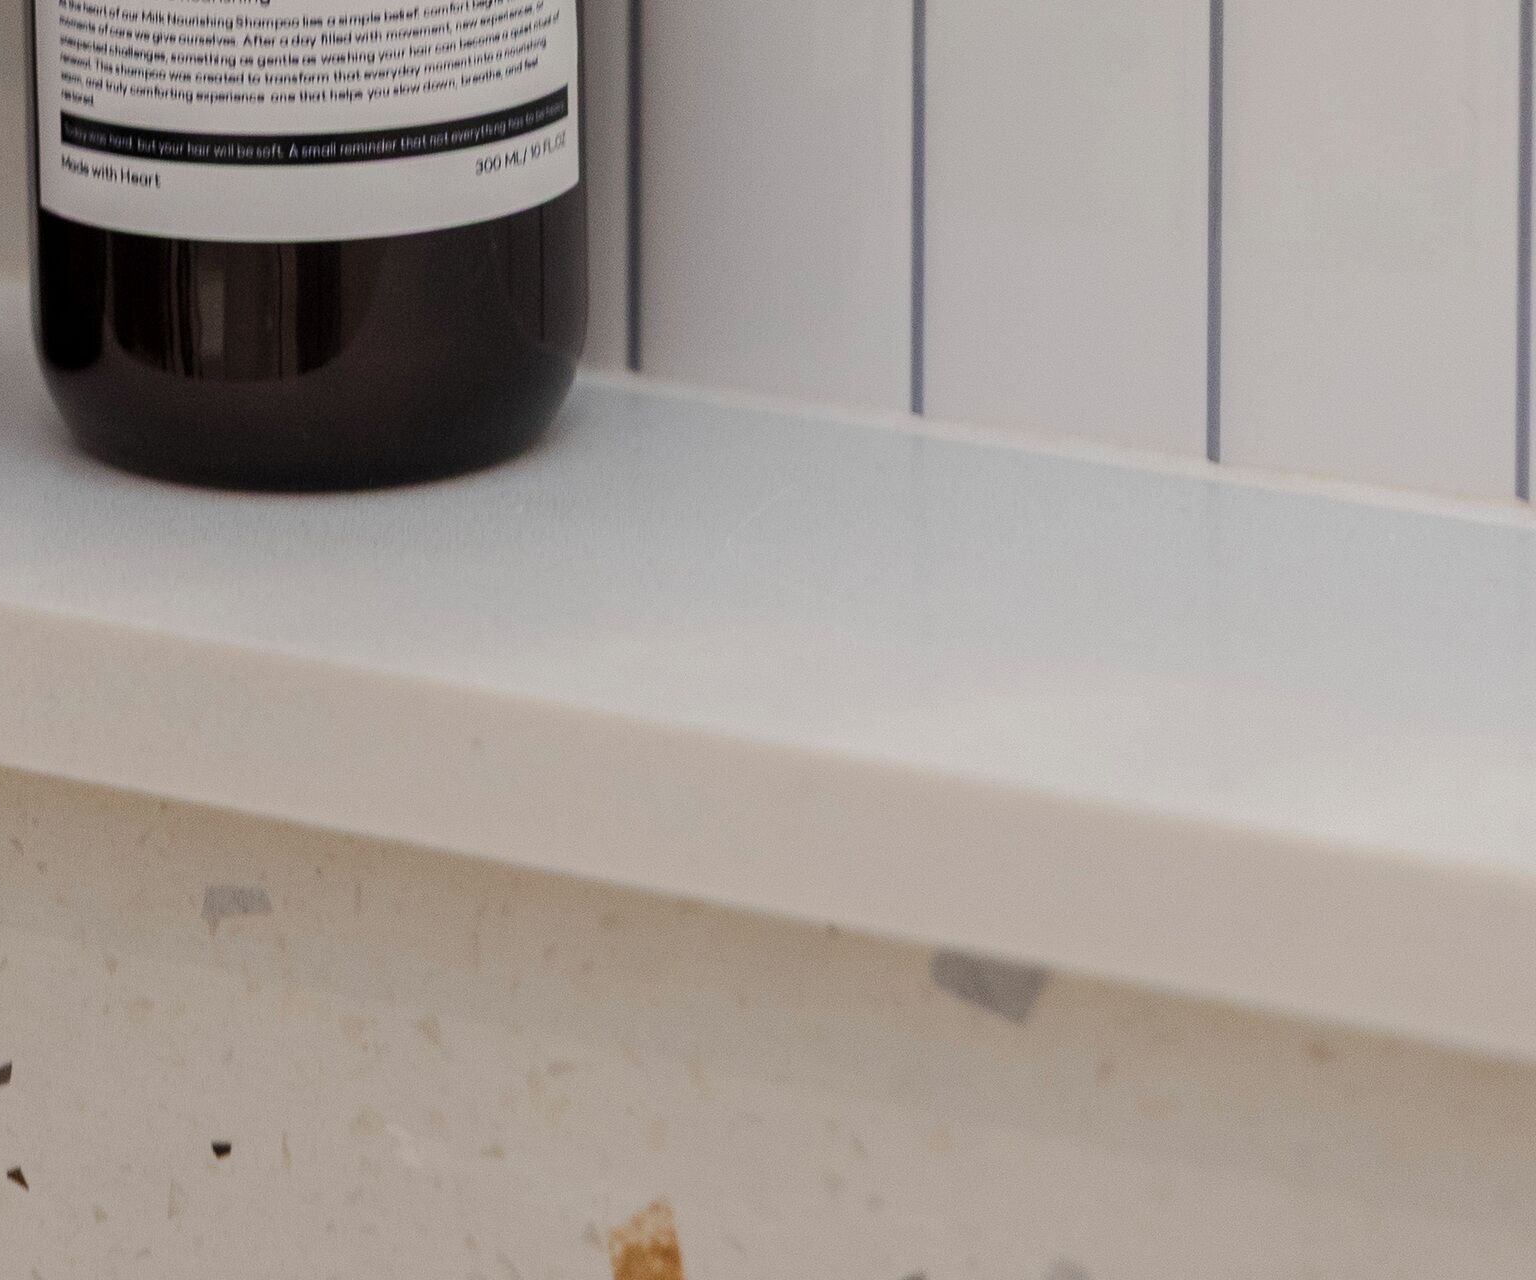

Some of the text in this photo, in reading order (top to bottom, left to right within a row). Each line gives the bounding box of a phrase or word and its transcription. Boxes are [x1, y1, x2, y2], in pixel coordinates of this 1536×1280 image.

[141, 9, 165, 25] Milk
[167, 12, 234, 31] Nourishing
[235, 15, 300, 31] Shampoo
[302, 15, 323, 28] lies
[338, 11, 381, 28] simple
[423, 0, 469, 18] comfort
[152, 31, 177, 46] give
[243, 34, 275, 47] After
[291, 33, 317, 49] day
[320, 31, 352, 46] filled
[355, 29, 383, 44] with
[455, 18, 478, 32] new
[170, 52, 237, 69] something
[257, 53, 300, 69] gentle
[321, 50, 376, 65] washing
[378, 49, 405, 64] your
[409, 44, 432, 58] hair
[434, 42, 457, 54] can
[115, 63, 167, 82] shampoo
[168, 71, 192, 83] was
[195, 72, 245, 85] created
[264, 71, 330, 85] transform
[333, 69, 360, 83] that
[363, 64, 421, 81] everyday
[424, 55, 472, 74] moment
[129, 85, 194, 104] comforting
[270, 93, 296, 103] one
[299, 89, 326, 102] that
[329, 87, 363, 103] helps
[367, 87, 390, 103] you
[393, 83, 421, 96] slow
[137, 137, 156, 152] but
[158, 142, 184, 156] your
[187, 142, 210, 157] hair
[213, 143, 234, 158] will
[301, 141, 337, 158] small
[340, 138, 396, 156] reminder
[400, 134, 426, 151] that
[429, 131, 449, 146] not
[120, 167, 160, 189] Heart
[476, 156, 502, 175] 300
